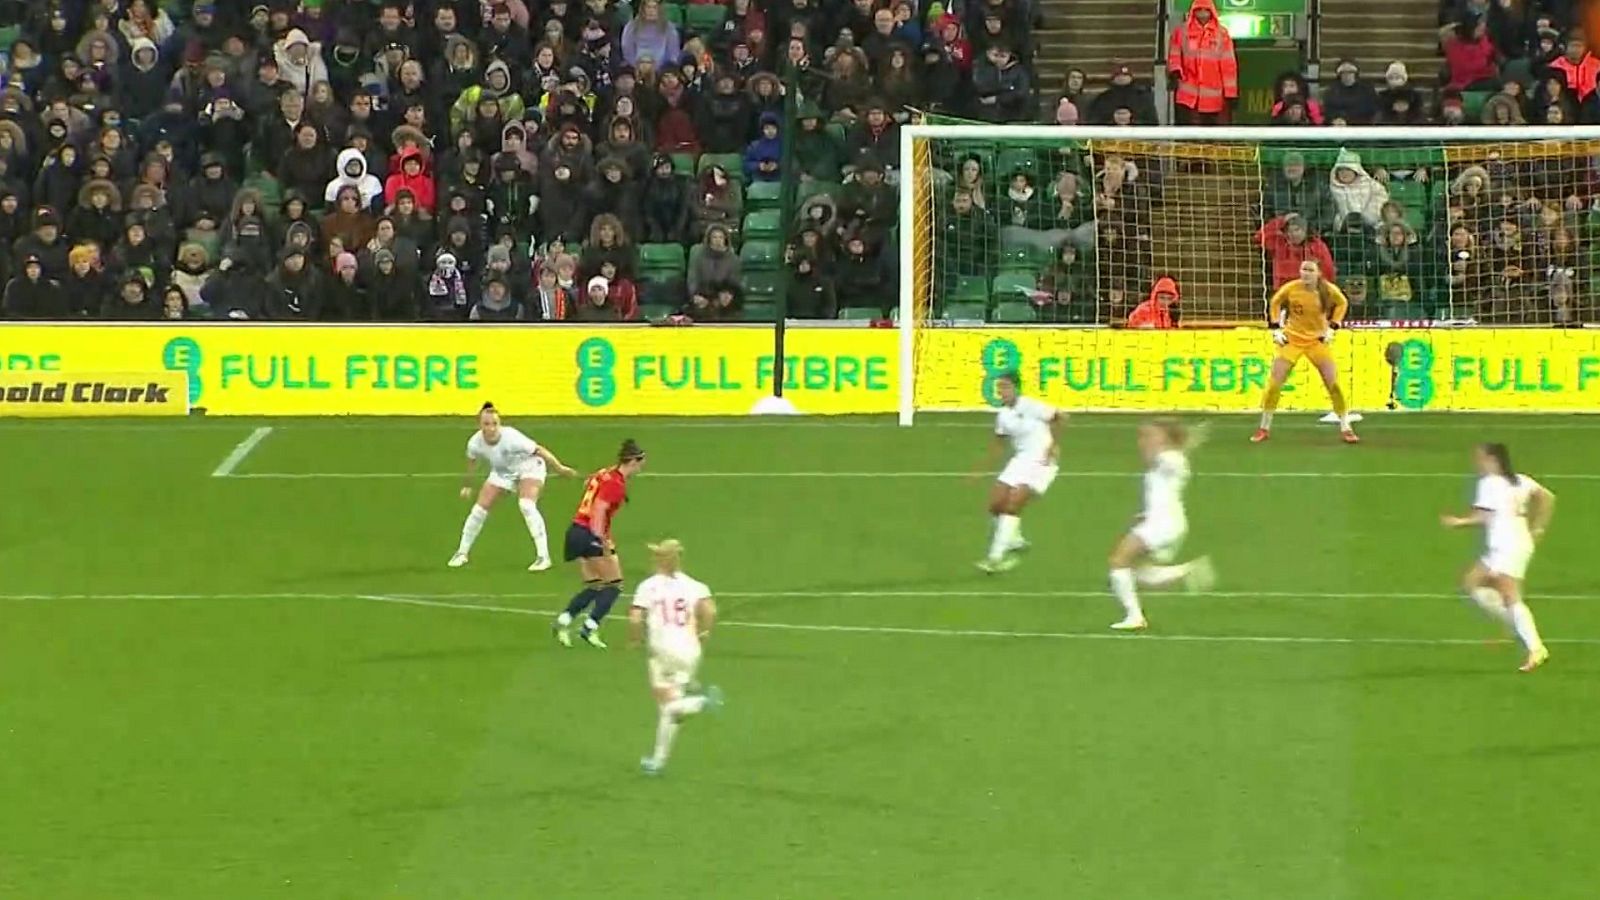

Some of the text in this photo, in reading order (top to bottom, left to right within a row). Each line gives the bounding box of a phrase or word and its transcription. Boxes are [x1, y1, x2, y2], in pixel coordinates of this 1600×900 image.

[221, 354, 331, 390] FULL
[346, 354, 479, 391] FIBRE
[633, 355, 742, 390] FULL
[756, 355, 889, 392] FIBRE
[1039, 356, 1145, 391] FULL
[1453, 356, 1563, 391] FULL
[0, 381, 170, 403] old Clark
